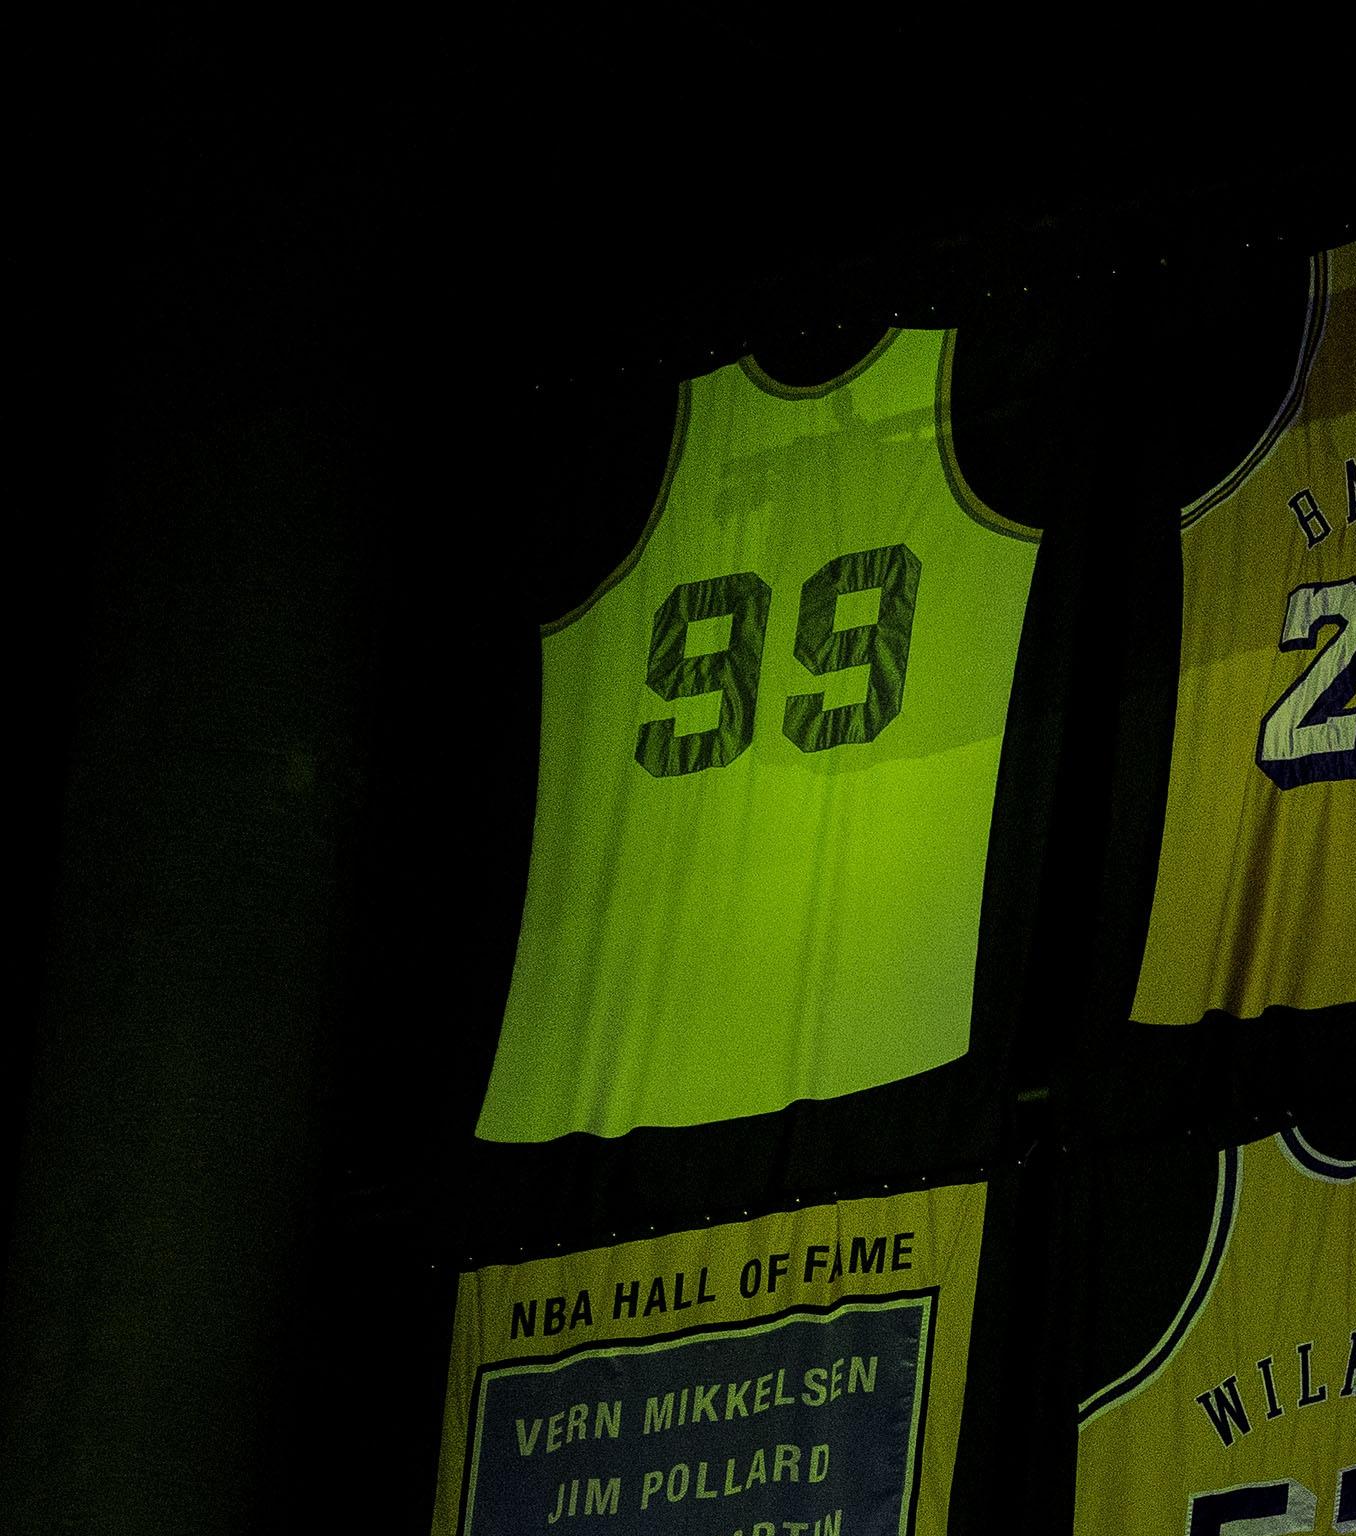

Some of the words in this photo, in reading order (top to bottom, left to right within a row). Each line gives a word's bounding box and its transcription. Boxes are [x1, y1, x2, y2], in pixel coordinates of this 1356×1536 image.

[635, 543, 922, 777] 99
[510, 1292, 593, 1339] NBA
[612, 1267, 716, 1320] HALL
[740, 1253, 789, 1299] OF
[804, 1232, 915, 1284] FAME
[515, 1400, 622, 1457] VERN
[643, 1356, 879, 1435] MIKKELSEN
[548, 1478, 622, 1524] JIM
[640, 1444, 830, 1510] POLLARD
